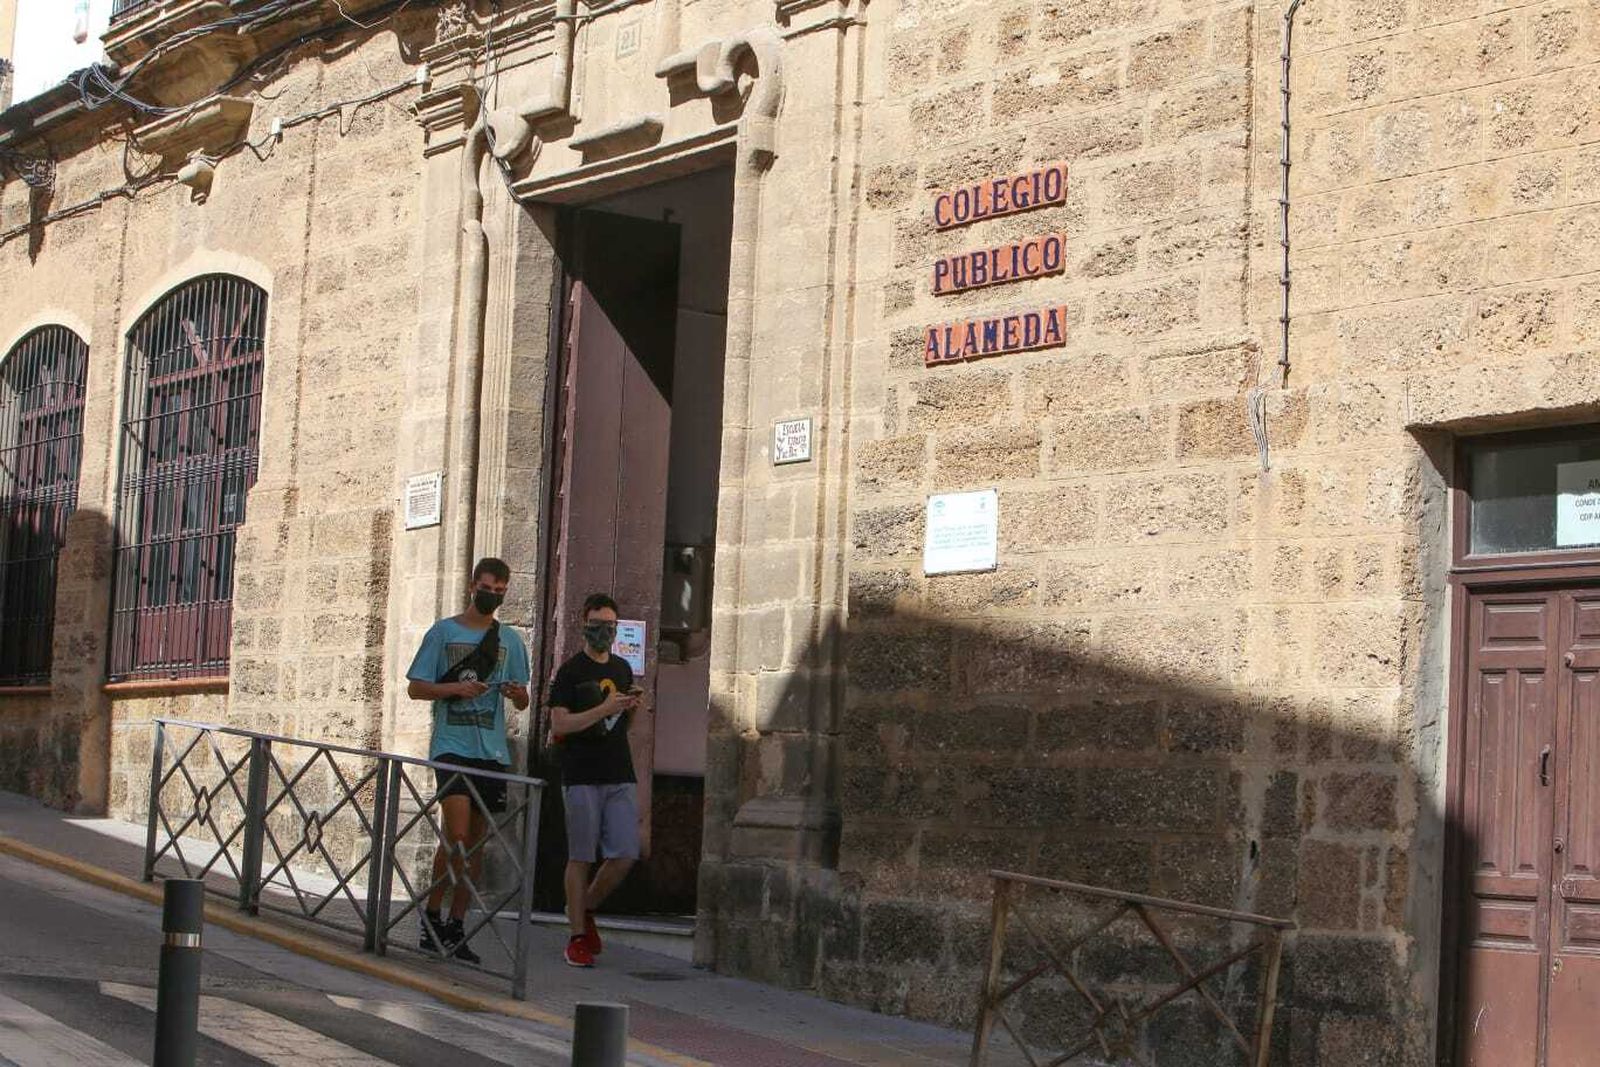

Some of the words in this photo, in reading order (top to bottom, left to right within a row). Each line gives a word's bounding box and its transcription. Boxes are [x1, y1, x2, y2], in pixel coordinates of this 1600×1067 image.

[934, 167, 1063, 227] COLEGIO
[934, 236, 1061, 292] PUBLICO
[925, 308, 1063, 362] ALAMEDA
